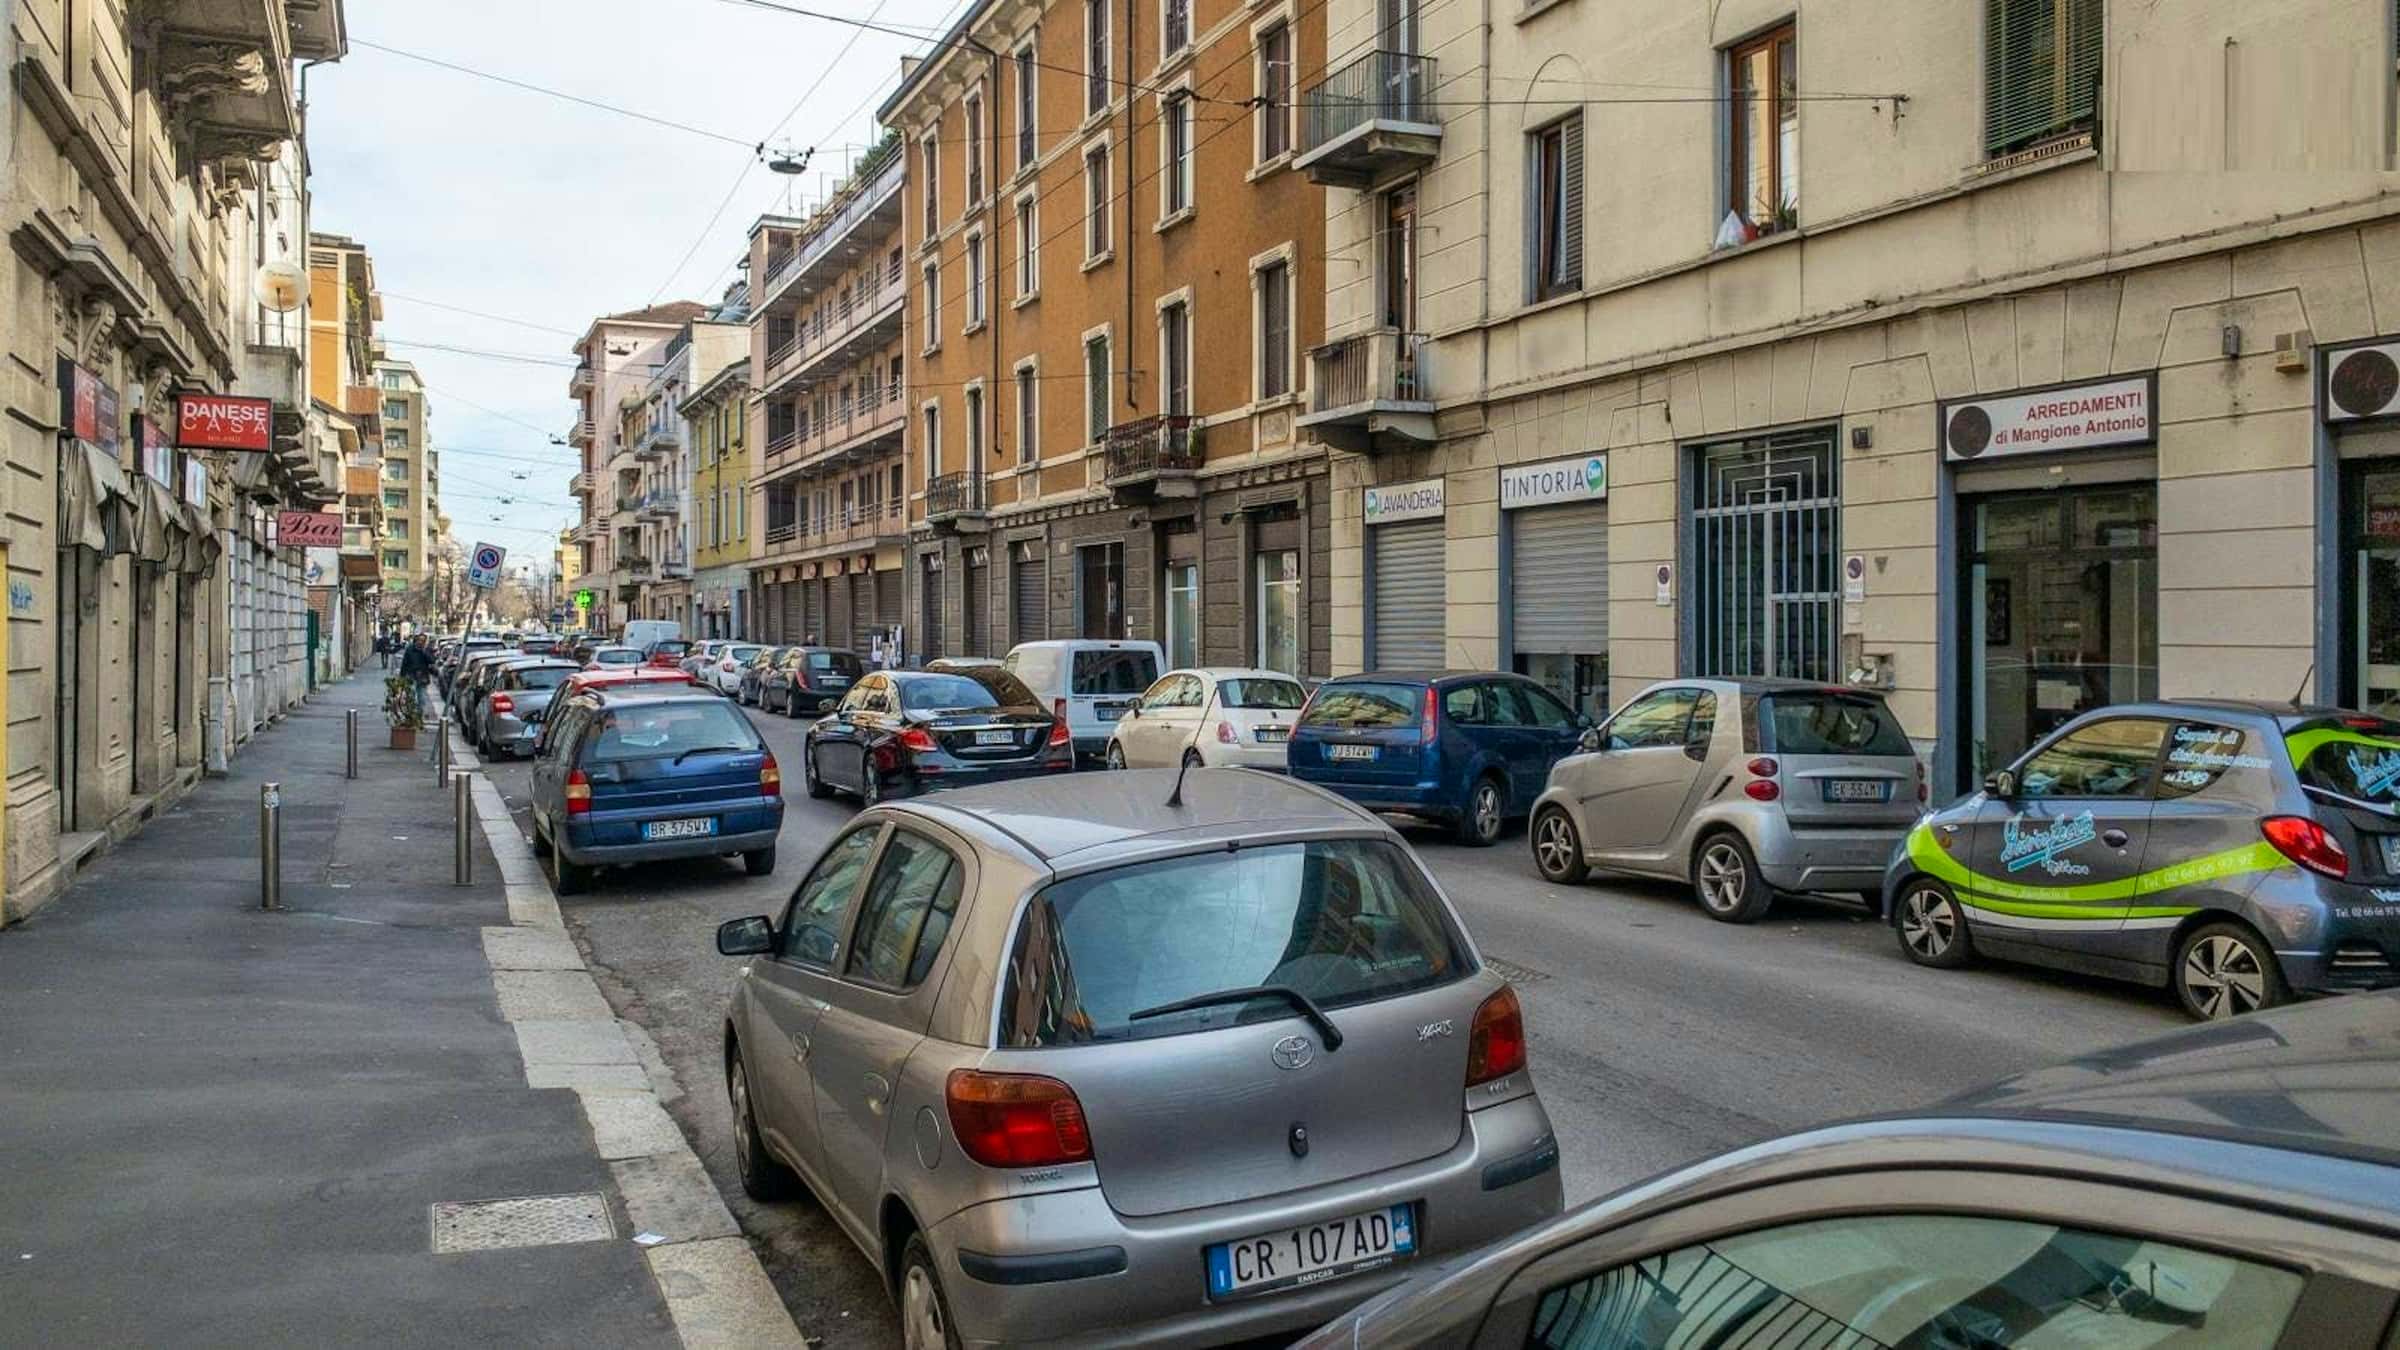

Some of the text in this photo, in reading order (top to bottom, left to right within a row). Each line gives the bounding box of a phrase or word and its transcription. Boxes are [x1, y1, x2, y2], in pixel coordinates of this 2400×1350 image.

[183, 401, 267, 421] DANESE
[2026, 392, 2142, 421] ARREDAMENTI
[182, 415, 267, 436] CASA
[1995, 415, 2146, 445] di Mangione Antonio
[1503, 469, 1585, 498] TINTORIA
[1379, 488, 1442, 514] LAVANDERIA
[281, 514, 339, 535] Bar
[651, 821, 666, 836] BR
[1416, 1019, 1453, 1041] YARIS
[1234, 1213, 1390, 1283] CR 107AD
